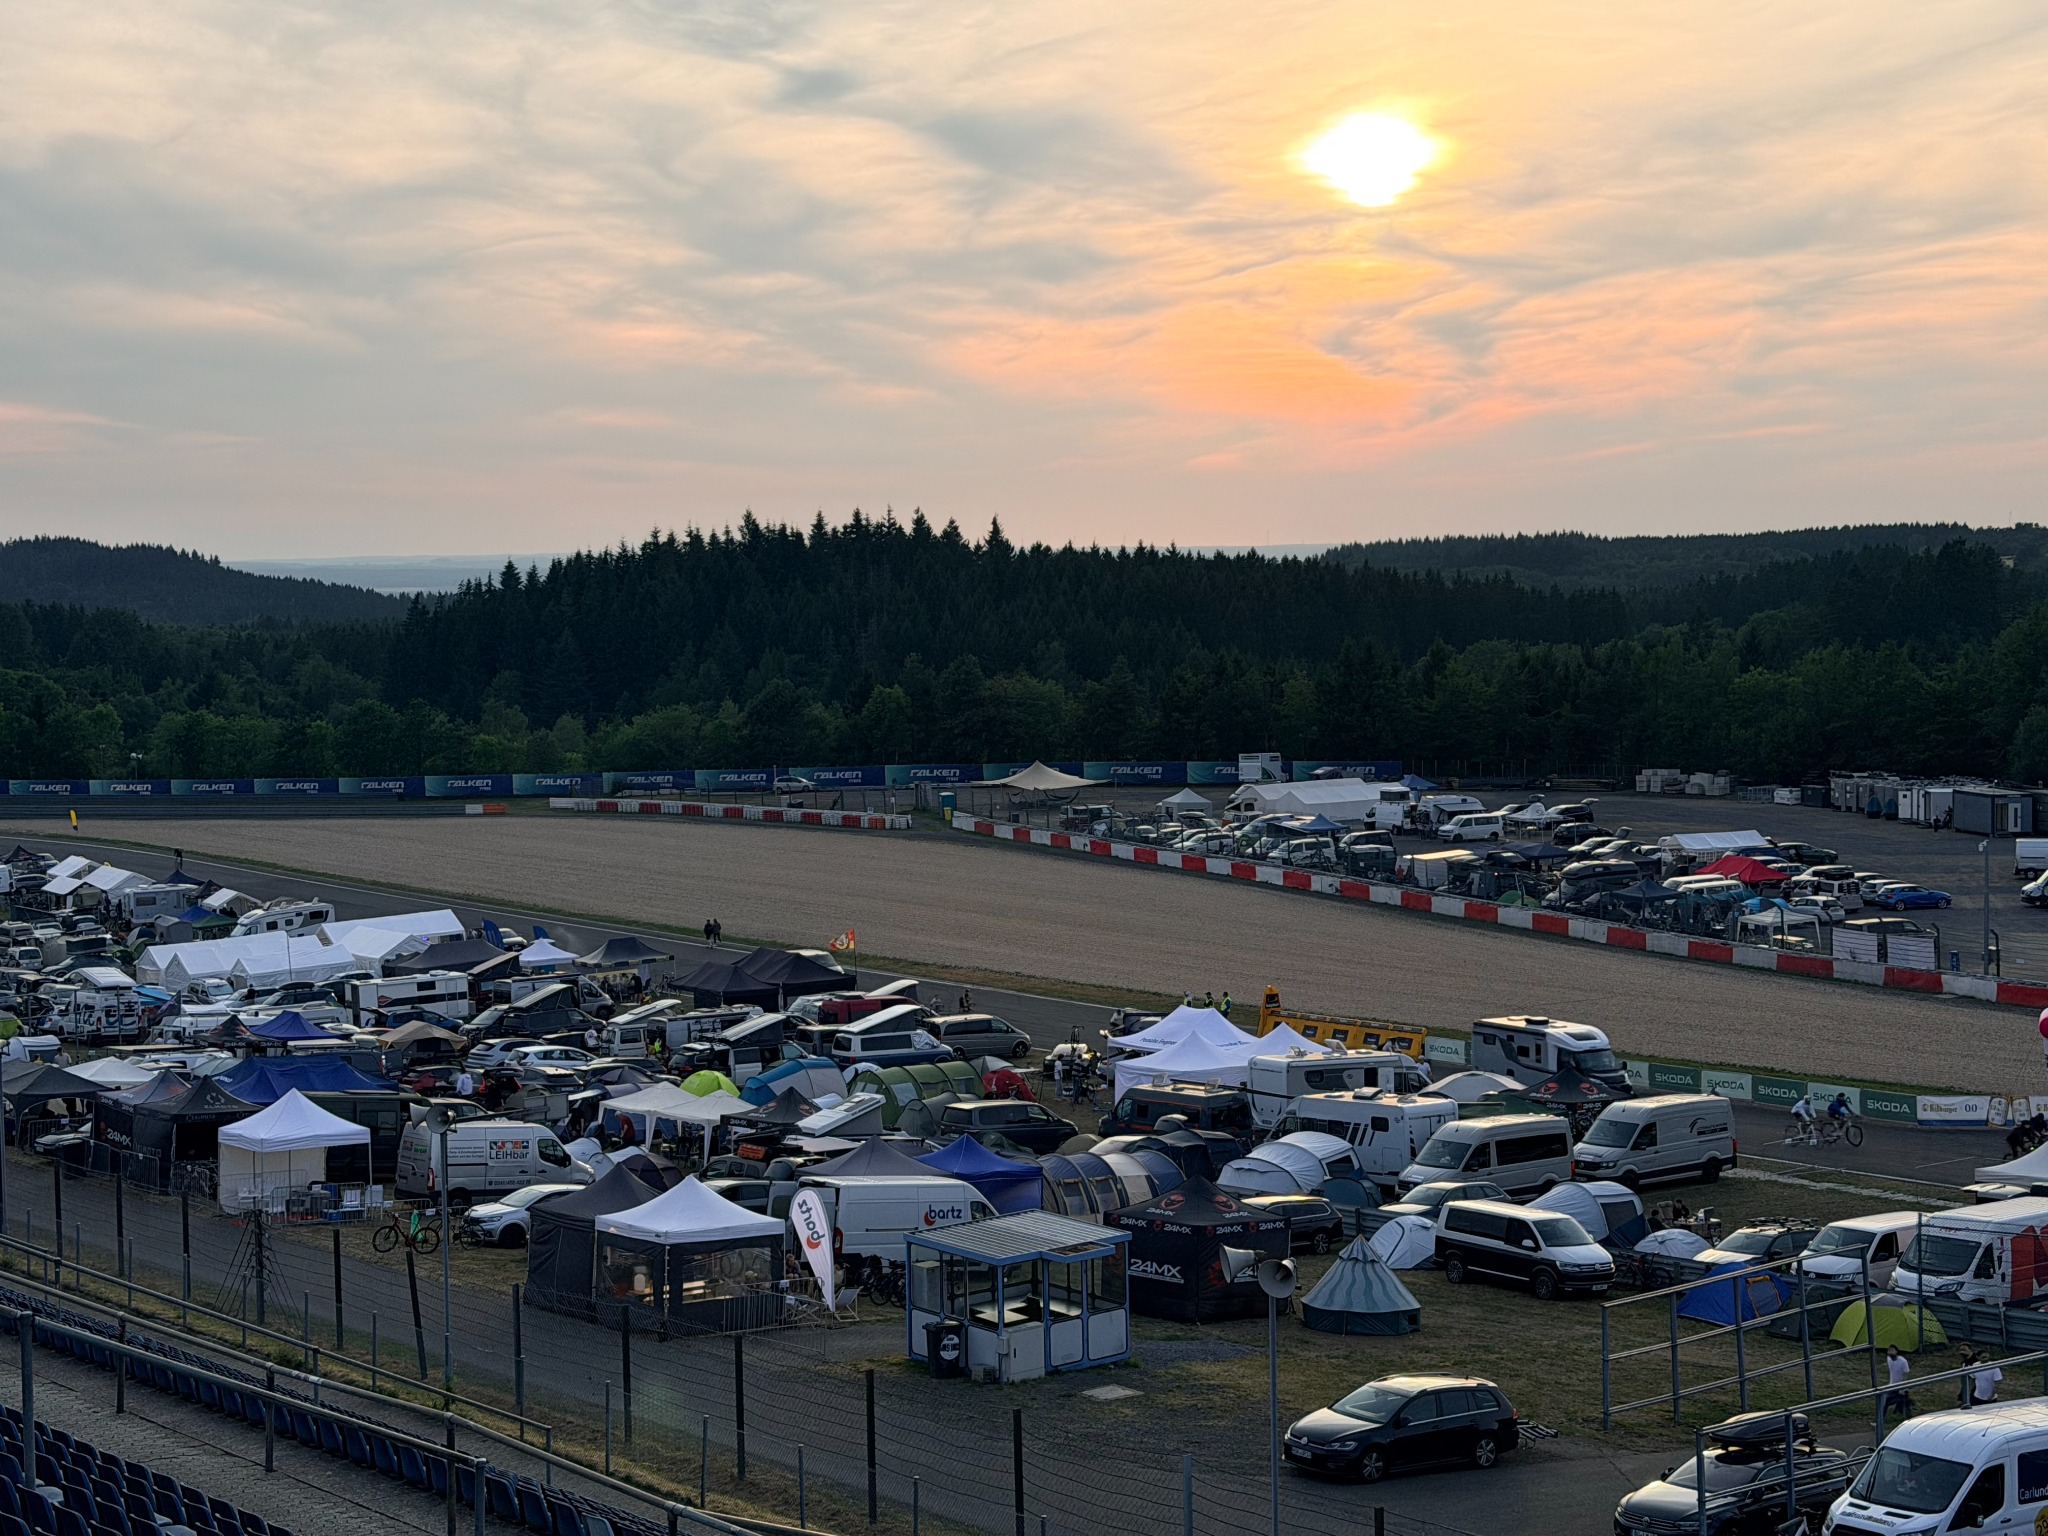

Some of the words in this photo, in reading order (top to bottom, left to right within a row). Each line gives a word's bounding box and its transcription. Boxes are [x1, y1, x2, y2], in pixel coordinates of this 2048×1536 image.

[910, 769, 960, 777] FALKEN
[1110, 766, 1162, 774] FALKEN
[1214, 766, 1239, 774] FAL
[627, 775, 673, 784] FALKEN
[719, 773, 767, 782] FALKEN
[814, 771, 862, 779] FALKEN
[276, 782, 319, 790] FALKEN
[361, 781, 404, 789] FALKEN
[447, 779, 492, 787] FALKEN
[536, 777, 581, 786] FALKEN
[192, 783, 234, 791] FALKEN
[1429, 1044, 1460, 1056] SKODA
[1655, 1073, 1693, 1085] SKODA
[1707, 1079, 1745, 1091] SKODA
[1758, 1085, 1798, 1098] SKODA
[1813, 1092, 1853, 1105] SKOA
[1867, 1100, 1910, 1113] SKODA
[107, 1128, 132, 1147] 24MX
[490, 1151, 529, 1159] LEIHbar
[929, 1204, 962, 1220] bartz
[1120, 1216, 1148, 1228] 24MX
[1258, 1221, 1285, 1231] 24MX
[1164, 1223, 1192, 1235] 24MX
[1216, 1225, 1243, 1234] 24MX
[1130, 1259, 1182, 1278] 24MX
